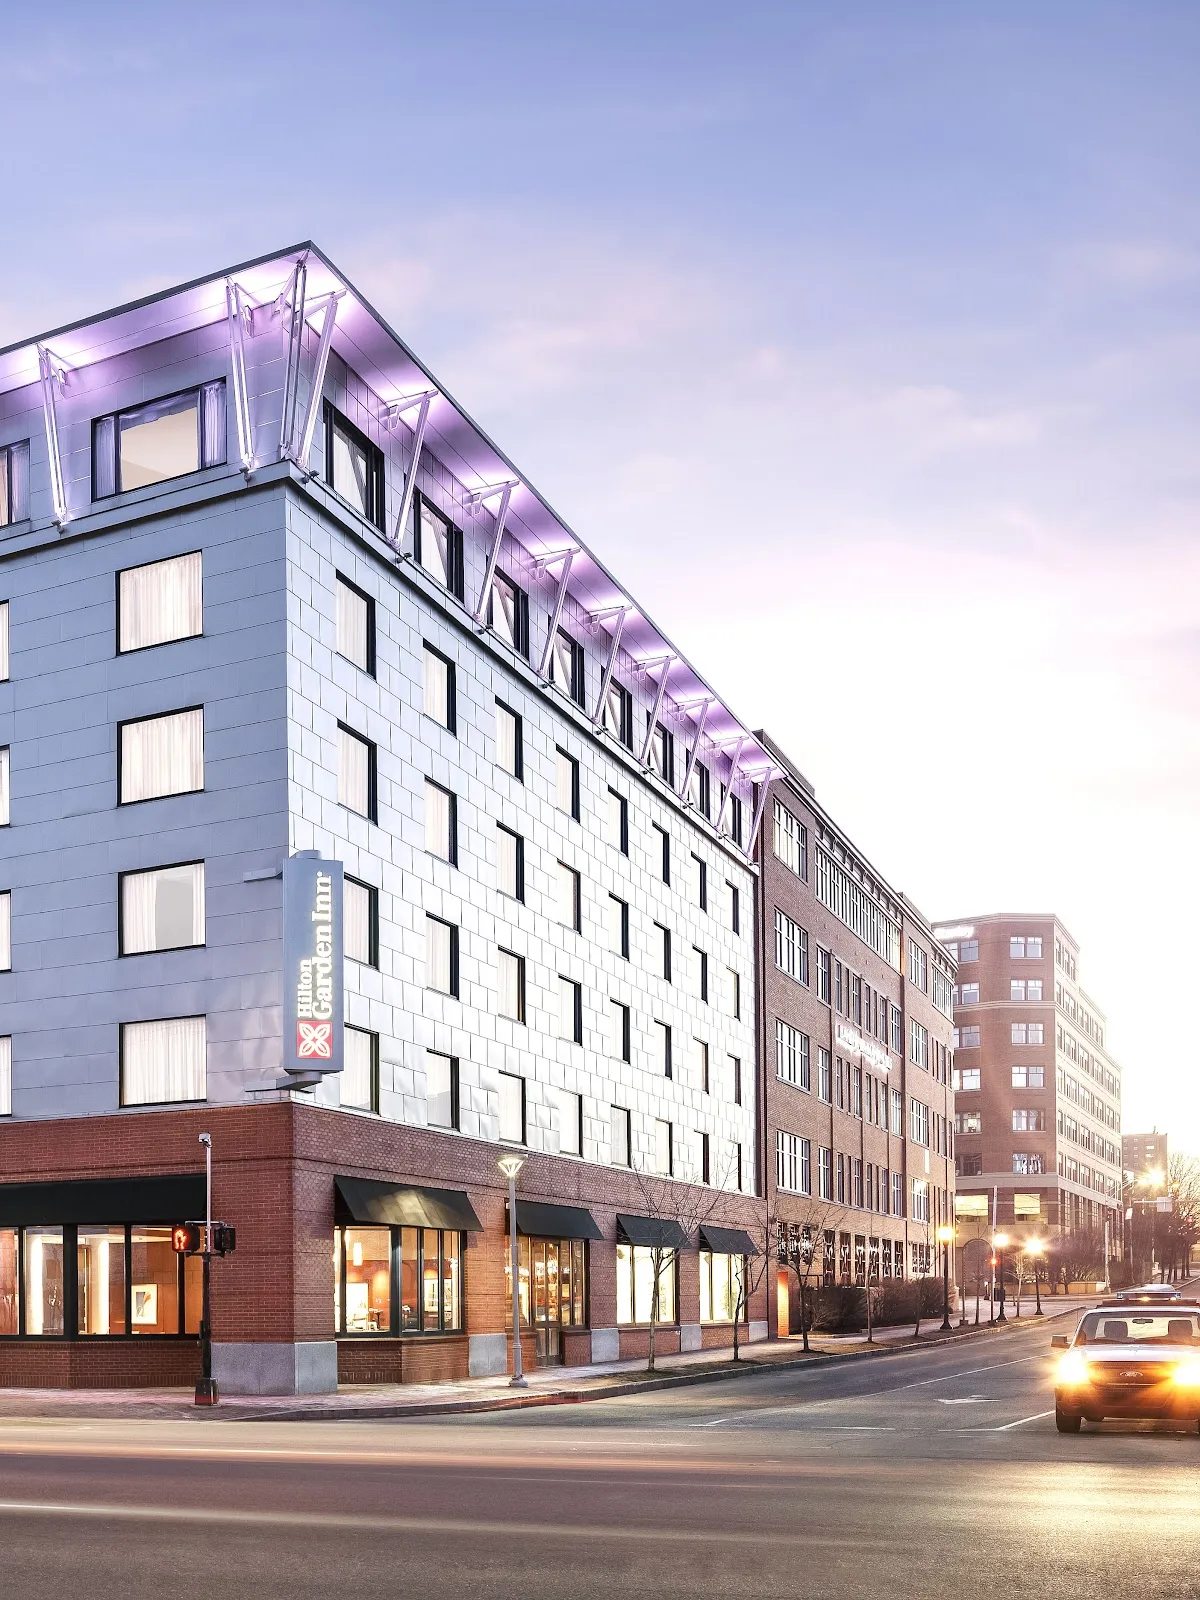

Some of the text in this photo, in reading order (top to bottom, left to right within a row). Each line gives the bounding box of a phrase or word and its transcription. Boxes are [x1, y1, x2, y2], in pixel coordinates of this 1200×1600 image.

[297, 959, 313, 1019] Hilton
[311, 875, 333, 1020] Garden Inn
